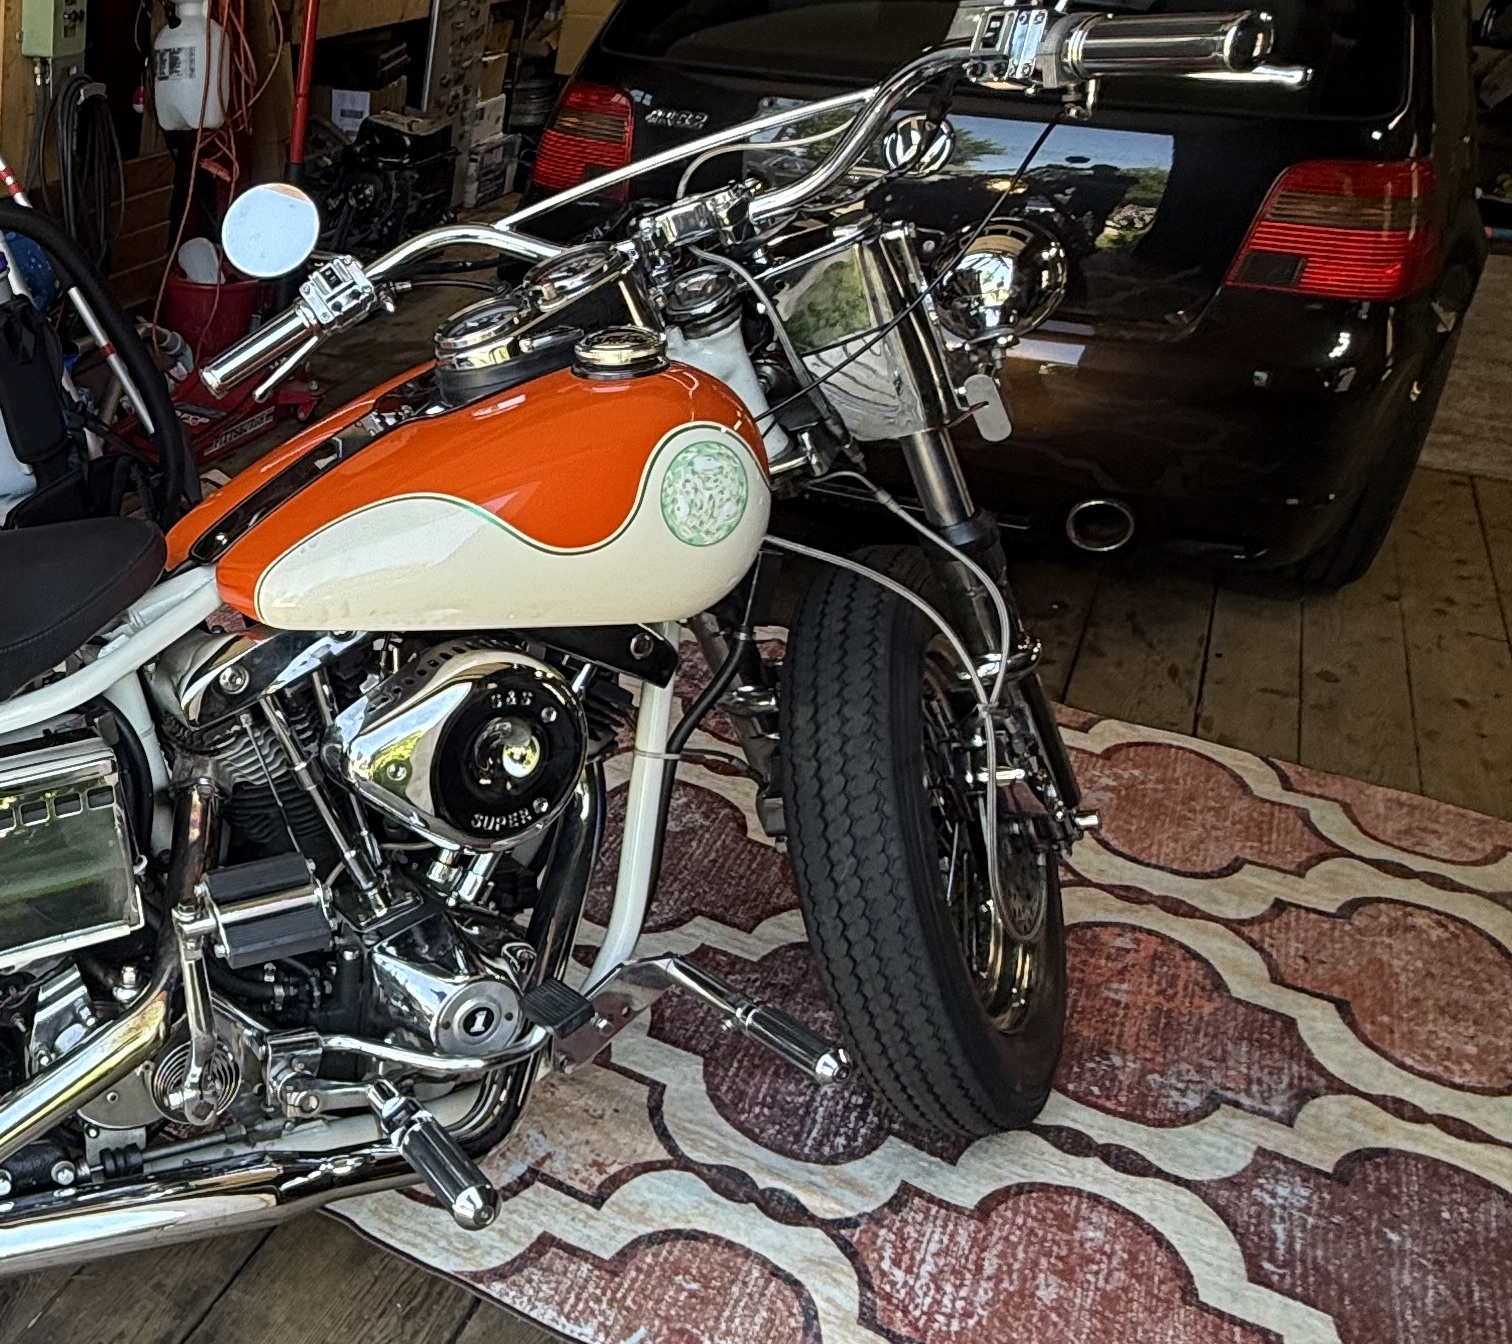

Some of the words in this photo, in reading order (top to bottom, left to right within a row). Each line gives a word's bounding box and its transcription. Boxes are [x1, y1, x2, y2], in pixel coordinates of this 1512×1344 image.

[491, 689, 534, 709] S&S
[470, 807, 533, 832] SUPER
[470, 1010, 488, 1033] 1
